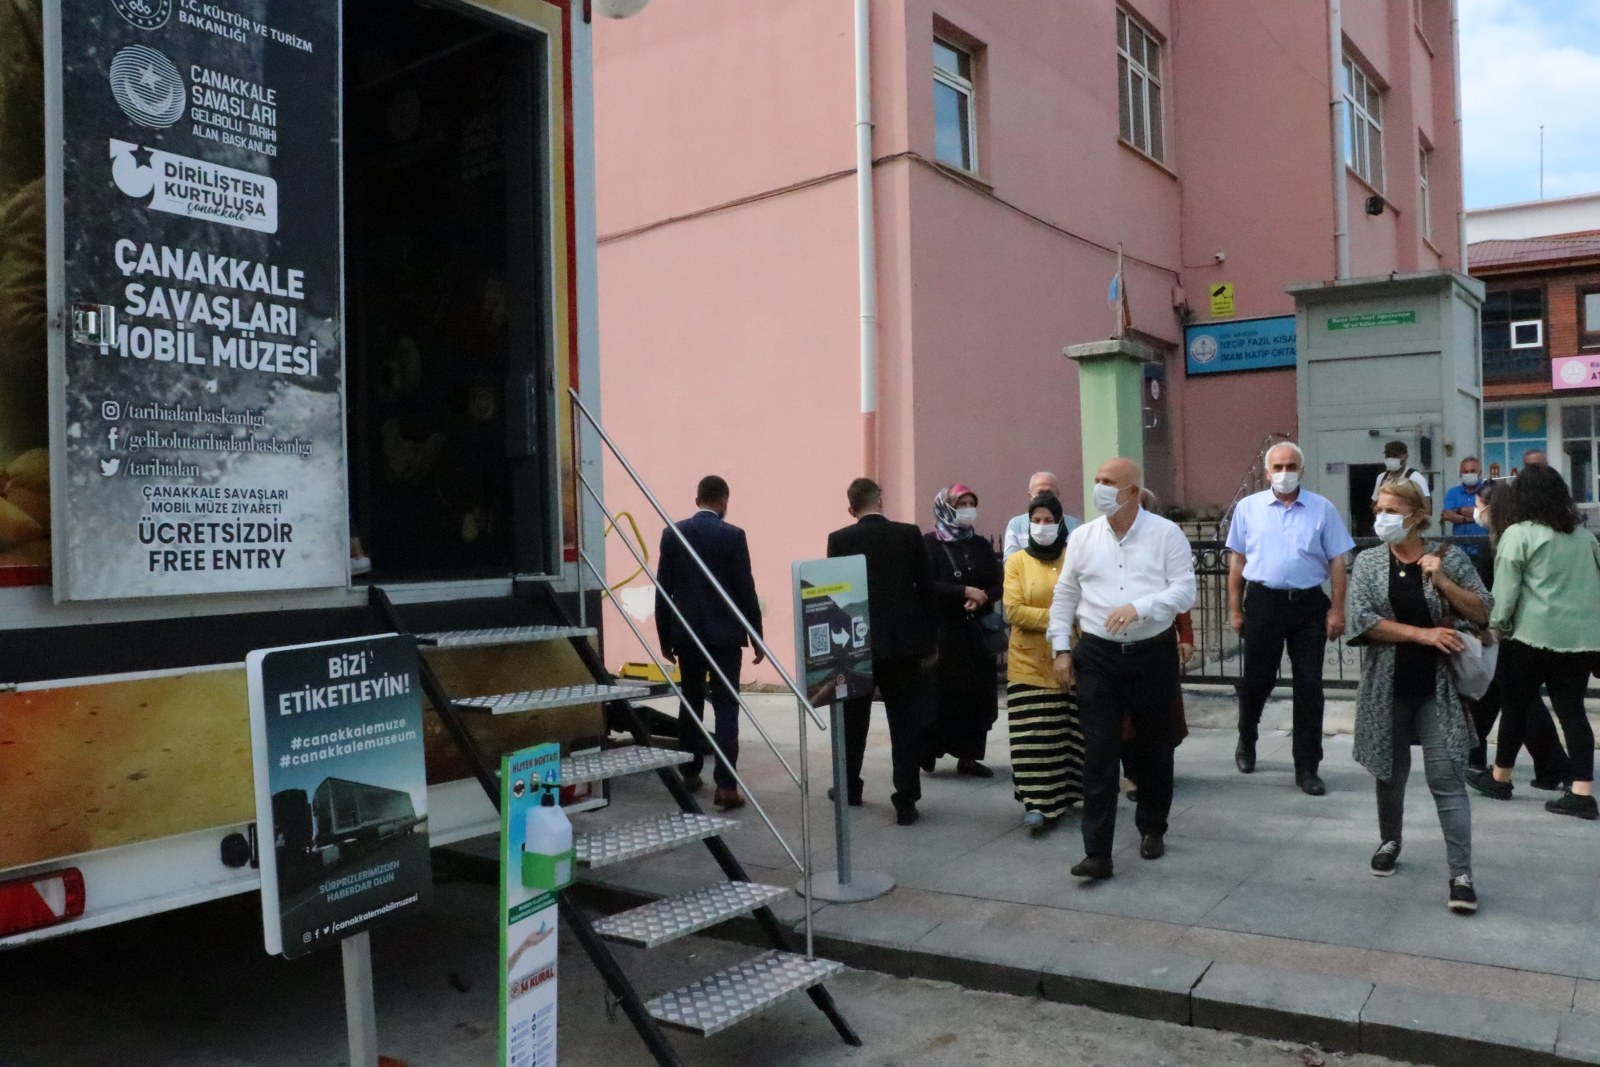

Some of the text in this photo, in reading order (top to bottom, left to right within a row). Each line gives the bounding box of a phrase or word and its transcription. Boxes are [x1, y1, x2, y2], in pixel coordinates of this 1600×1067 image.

[178, 10, 246, 44] BAKANLIĞI
[203, 4, 251, 31] KÜLTÜR
[252, 21, 268, 37] VE
[270, 28, 313, 54] TURİZM
[191, 85, 276, 127] SAVAŞLARI
[192, 123, 219, 142] ALAN
[164, 161, 265, 199] DİRİLİŞTEN
[164, 181, 266, 216] KURTULUŞA
[114, 238, 305, 300] ÇANAKKALE
[124, 282, 297, 337] SAVAŞLARI
[100, 322, 318, 377] MOBİL MÜZESİ
[142, 486, 289, 502] ÇANAKKALE SAVAŞLARI
[151, 499, 282, 515] MOBİL MÜZE ZİYARETİ
[138, 516, 293, 545] ÜCRETSİZDİR
[149, 548, 286, 572] FREE ENTRY
[328, 651, 367, 680] BİZİ
[279, 671, 410, 716] ETİKETLEYİN!
[279, 729, 416, 769] #canakkalemuseum
[291, 717, 406, 751] #canakkalemuze
[319, 859, 400, 894] SÜRPRİZLERİMİZDEN
[326, 872, 395, 903] HABERDAR OLUN
